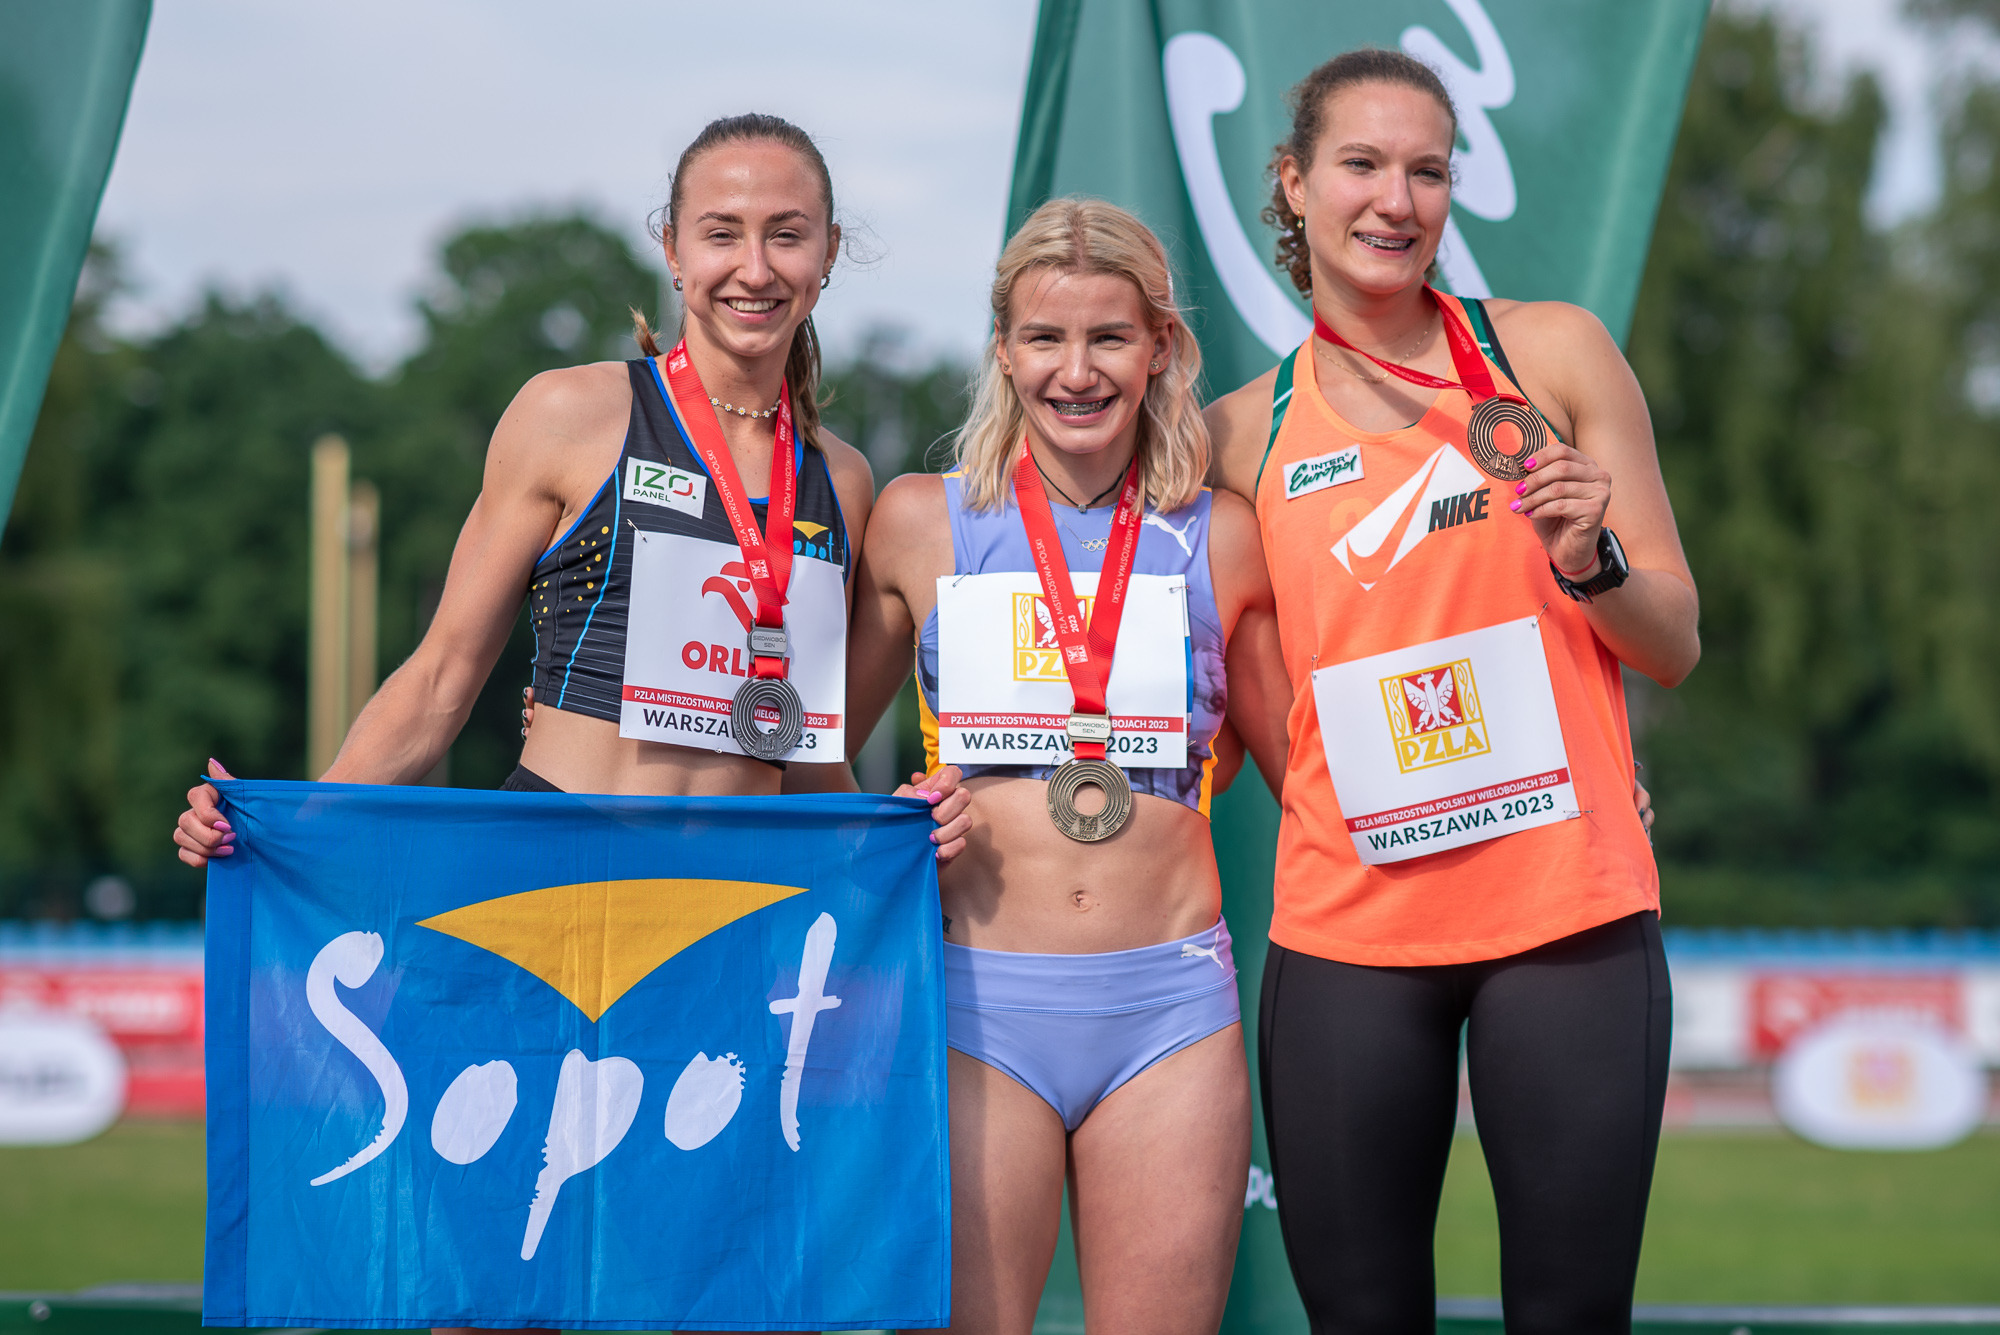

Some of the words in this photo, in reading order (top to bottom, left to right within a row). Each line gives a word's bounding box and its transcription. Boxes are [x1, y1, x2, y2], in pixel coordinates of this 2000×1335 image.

[706, 449, 722, 475] POLSKI
[784, 445, 792, 492] MISTRZOSTWA
[1289, 454, 1358, 493] Europol
[633, 488, 671, 503] PANEL
[718, 475, 744, 527] MISTRZOSTWA
[783, 492, 792, 518] POLSKI
[1428, 488, 1491, 533] NIKE
[1119, 506, 1129, 525] 2023
[740, 528, 750, 547] PZLA
[748, 527, 760, 546] 2023
[793, 531, 834, 563] opot
[1036, 538, 1050, 564] POLSKI
[1117, 530, 1134, 578] MISTRZOSTWA
[1044, 564, 1064, 615] MISTRZOSTWA
[1112, 578, 1124, 604] POLSKI
[1058, 617, 1069, 635] PZLA
[1068, 614, 1080, 633] 2023
[681, 640, 791, 680] ORL
[634, 689, 656, 702] PZLA
[656, 692, 716, 710] MISTRZOSTWA
[807, 716, 828, 726] 2023
[950, 716, 973, 725] PZLA
[974, 716, 1039, 726] MISTRZOSTWA
[1040, 717, 1068, 727] POLSK
[1112, 720, 1147, 729] BOJACH
[1148, 720, 1169, 730] 2023
[643, 708, 737, 740] WARSZA
[1106, 736, 1158, 754] 2023
[1399, 725, 1485, 767] PZLA
[1354, 818, 1374, 830] PZLA
[1374, 804, 1436, 826] MISTRZOSTWA
[1436, 796, 1466, 812] POLSKI
[1466, 794, 1476, 804] W
[1477, 779, 1538, 800] WIELOBOJACH
[1539, 774, 1559, 786] 2023
[1368, 808, 1498, 850] WARSZAWA
[1502, 793, 1554, 820] 2023
[306, 912, 842, 1261] Sopot
